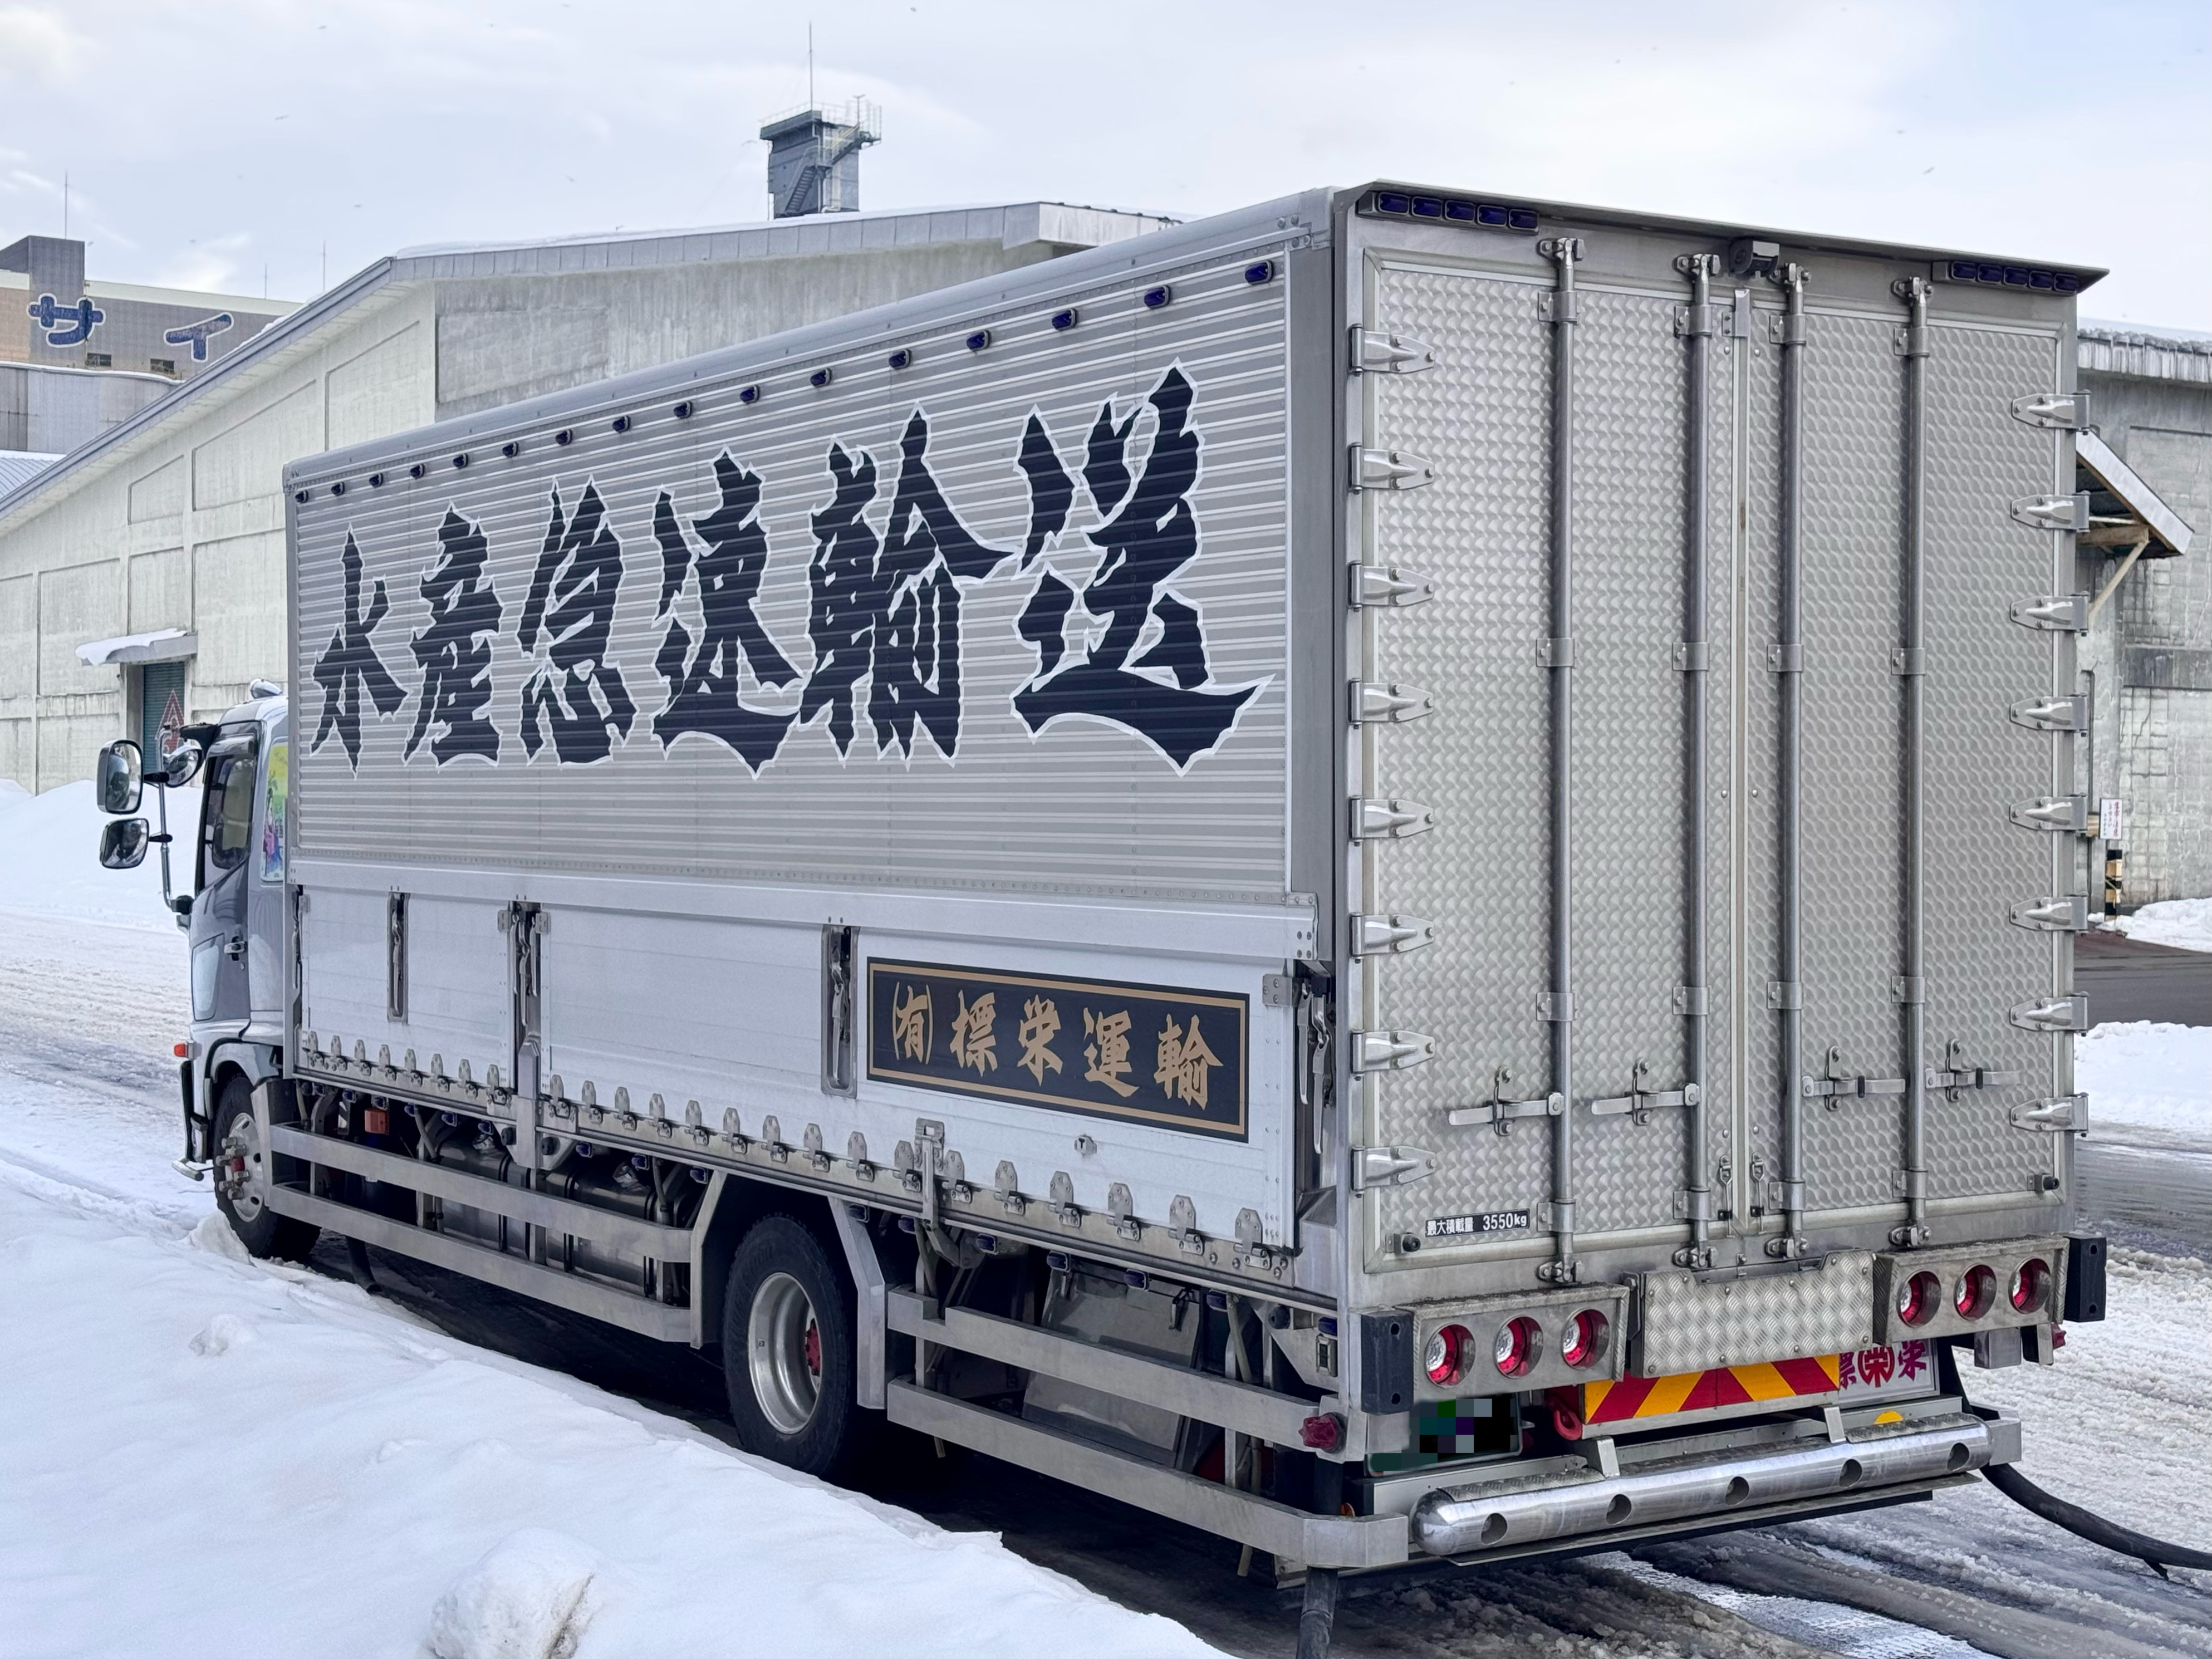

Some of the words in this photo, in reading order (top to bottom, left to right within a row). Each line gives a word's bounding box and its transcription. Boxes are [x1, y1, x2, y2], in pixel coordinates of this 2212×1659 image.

[310, 357, 1276, 778] 水産急速輸送
[1427, 1216, 1474, 1236] 最大積載量
[1483, 1213, 1527, 1231] 3550kg
